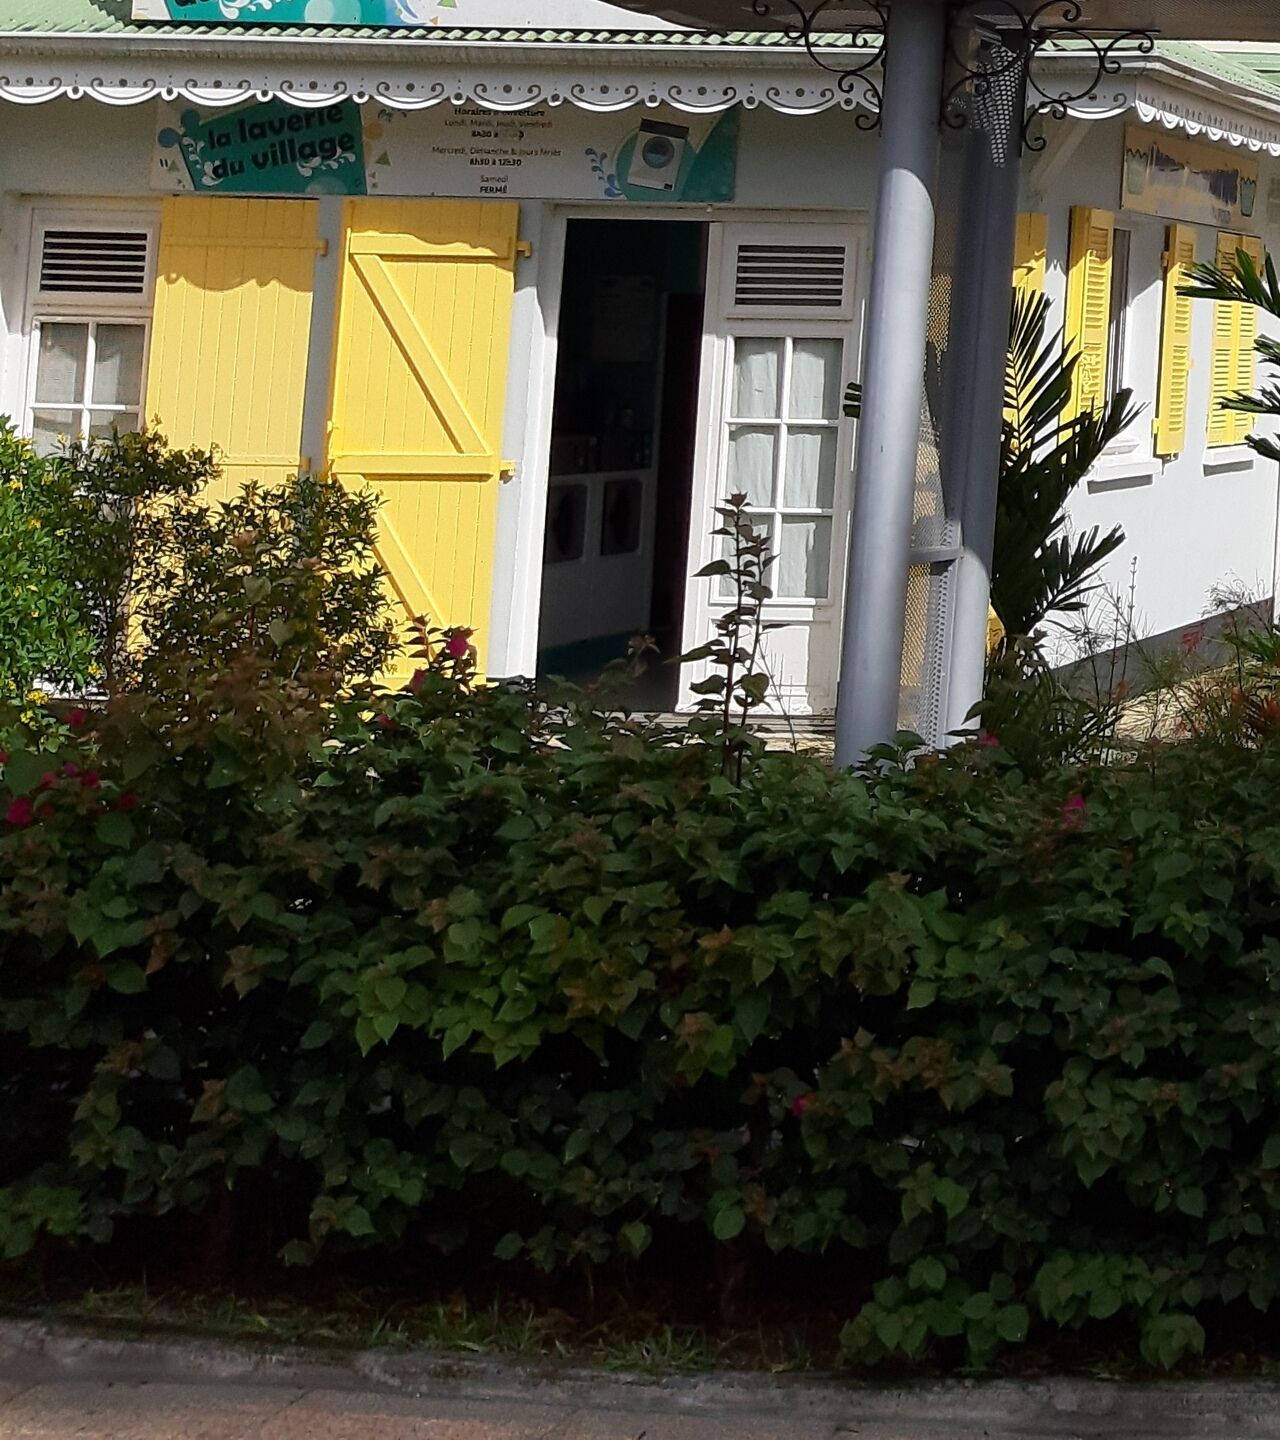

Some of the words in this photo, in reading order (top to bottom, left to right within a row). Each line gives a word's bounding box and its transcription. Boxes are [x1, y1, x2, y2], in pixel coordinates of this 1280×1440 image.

[208, 129, 232, 149] la
[212, 159, 245, 179] du
[251, 132, 355, 170] village
